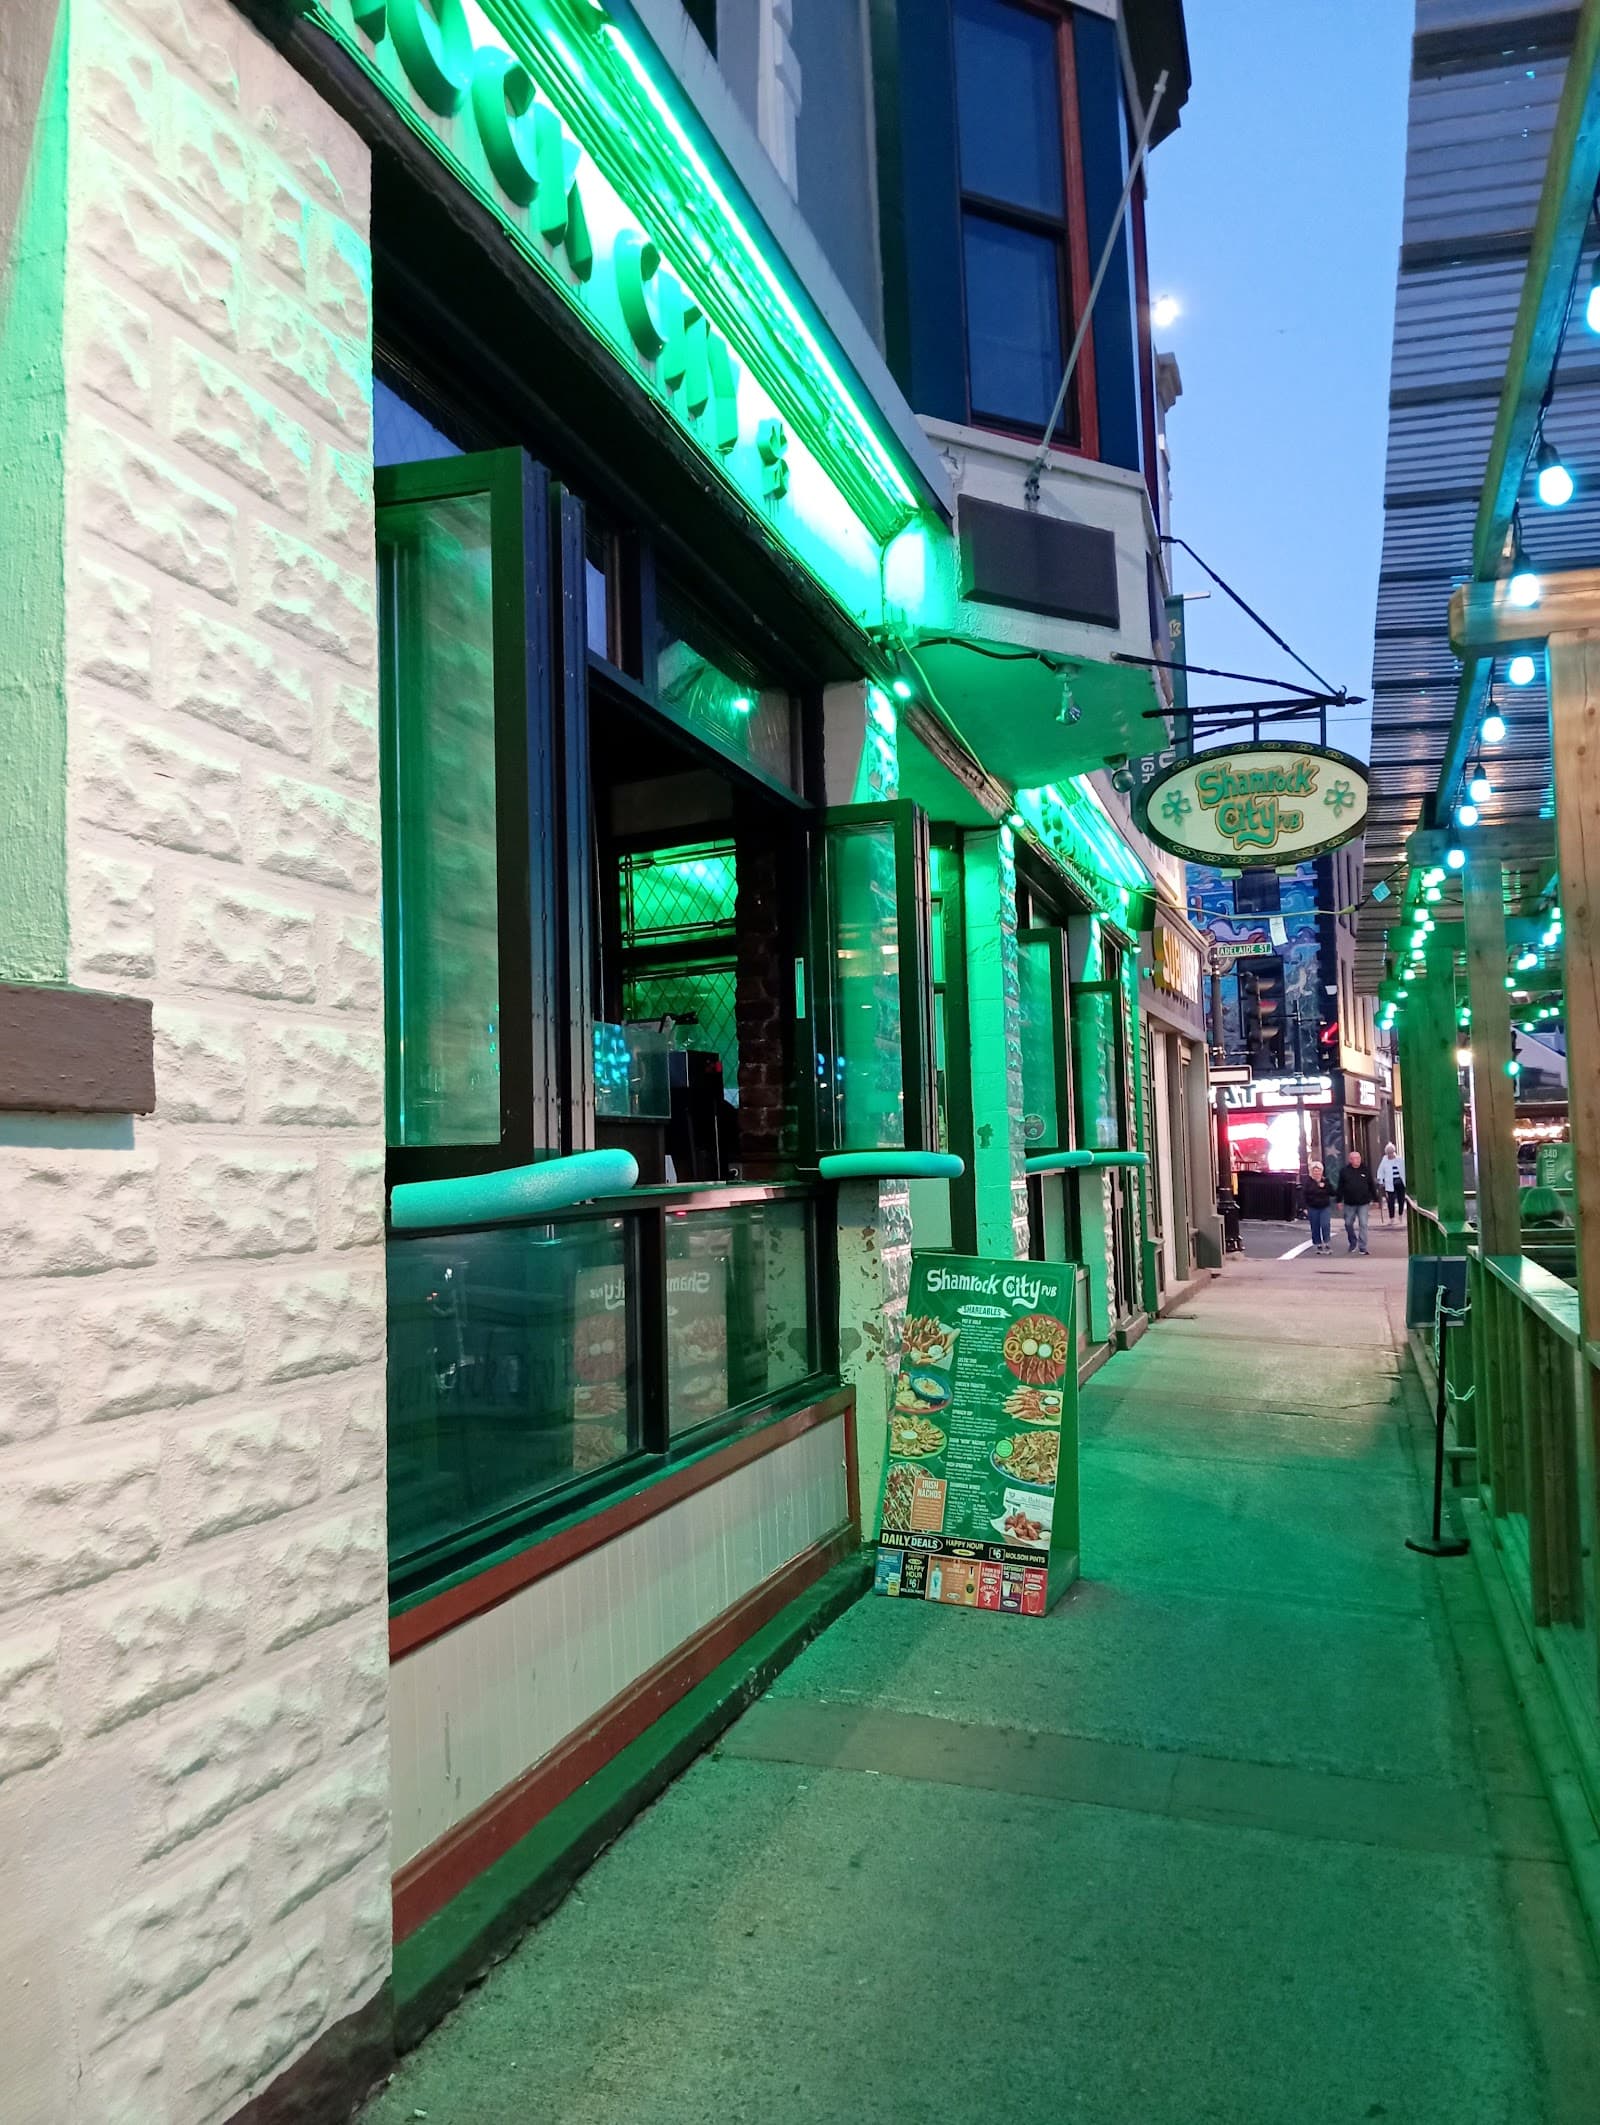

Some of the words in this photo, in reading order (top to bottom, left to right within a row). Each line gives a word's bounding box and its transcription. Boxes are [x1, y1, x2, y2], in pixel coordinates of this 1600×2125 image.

[1196, 758, 1318, 807] Shamrock
[1216, 797, 1278, 848] City
[1278, 809, 1303, 831] PUB
[1220, 945, 1255, 956] ADELAIDE
[1260, 944, 1268, 953] ST
[927, 1267, 1000, 1295] Shamrock
[1002, 1274, 1041, 1309] City
[1041, 1285, 1057, 1297] PUB
[963, 1305, 1001, 1316] SHAREABLES
[922, 1480, 939, 1490] IRISH
[917, 1489, 942, 1499] NACHOS
[881, 1533, 910, 1547] DAILY
[911, 1537, 938, 1549] DEALS
[945, 1539, 966, 1548] HAPPY
[966, 1541, 984, 1550] HOUR
[1005, 1551, 1028, 1561] MOLSON
[1029, 1554, 1046, 1564] PINTS
